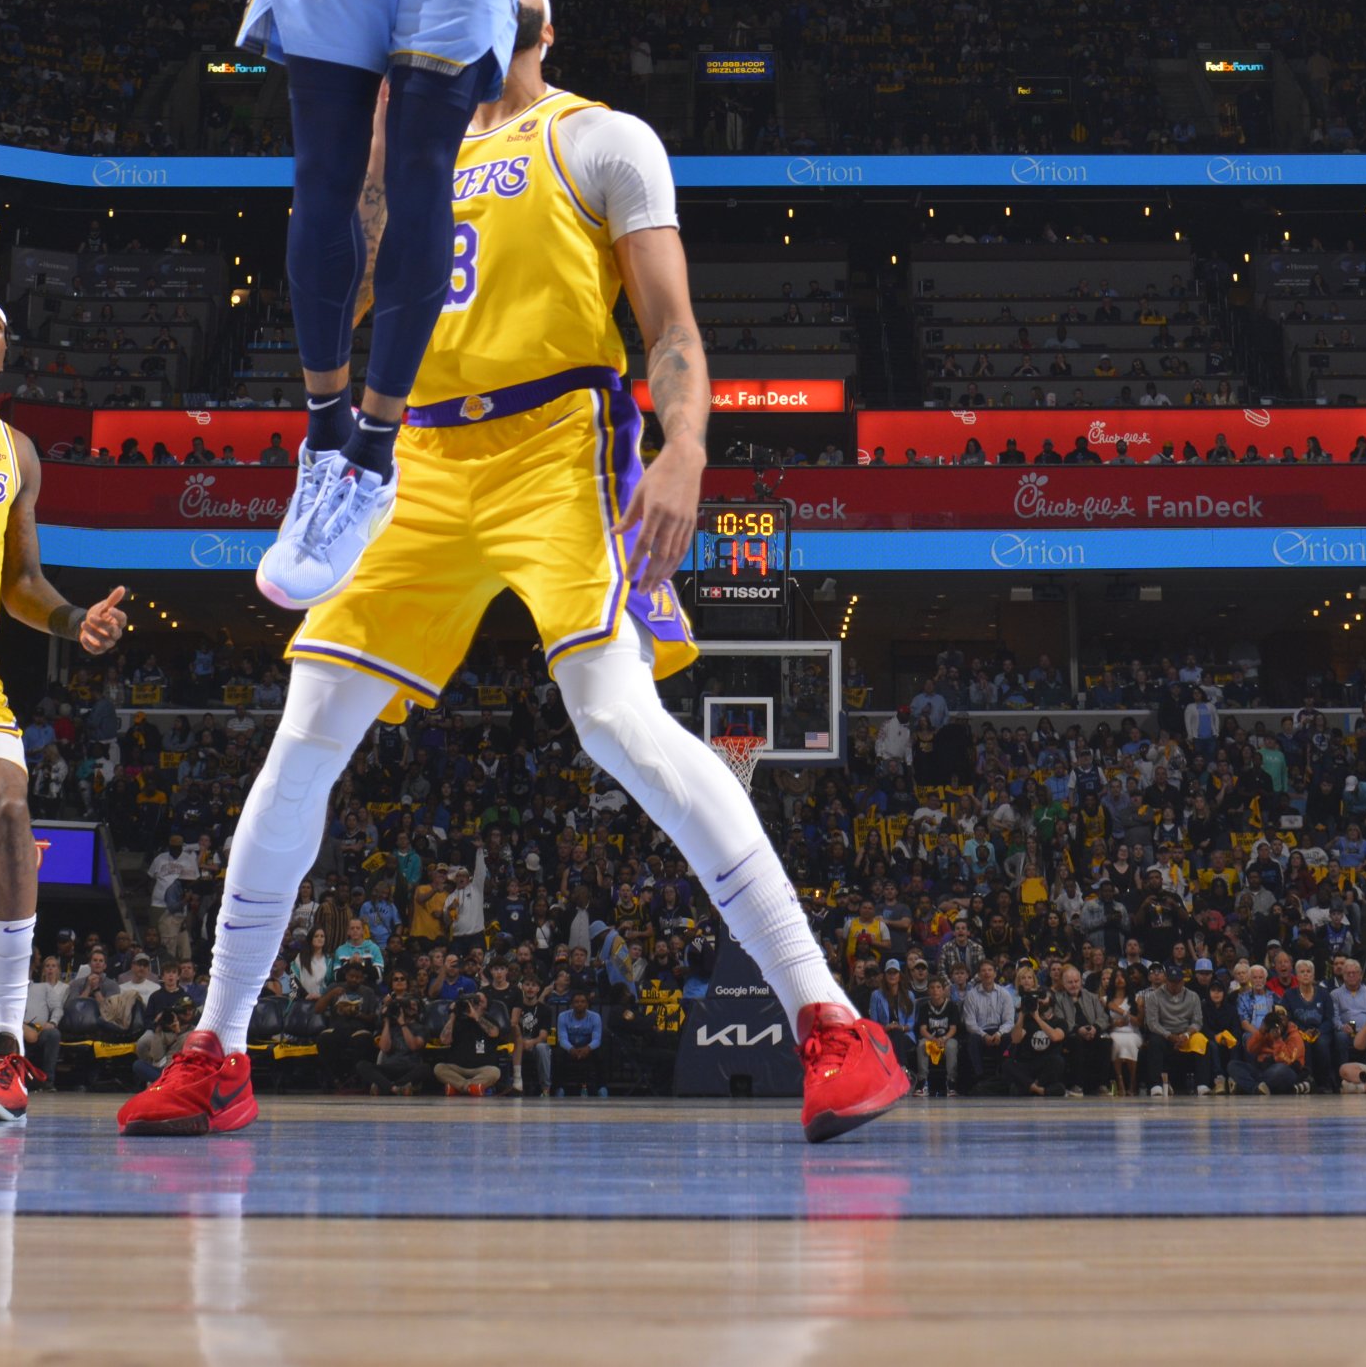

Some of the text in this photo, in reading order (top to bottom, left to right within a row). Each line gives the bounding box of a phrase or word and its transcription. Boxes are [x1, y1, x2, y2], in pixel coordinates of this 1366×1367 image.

[92, 160, 167, 186] Orion
[787, 157, 862, 183] Orion
[1010, 156, 1087, 183] Orion
[1206, 156, 1282, 183] Orion
[443, 221, 479, 314] 3
[738, 391, 808, 406] FanDeck
[1014, 483, 1263, 521] Chick-fil-A FanDeck
[717, 513, 773, 536] 10:58
[732, 540, 767, 576] 14
[991, 534, 1084, 567] Orion
[1273, 531, 1366, 565] Orion
[723, 587, 780, 598] TISSOT
[715, 986, 769, 997] Google Pixel
[697, 1023, 782, 1045] KIA
